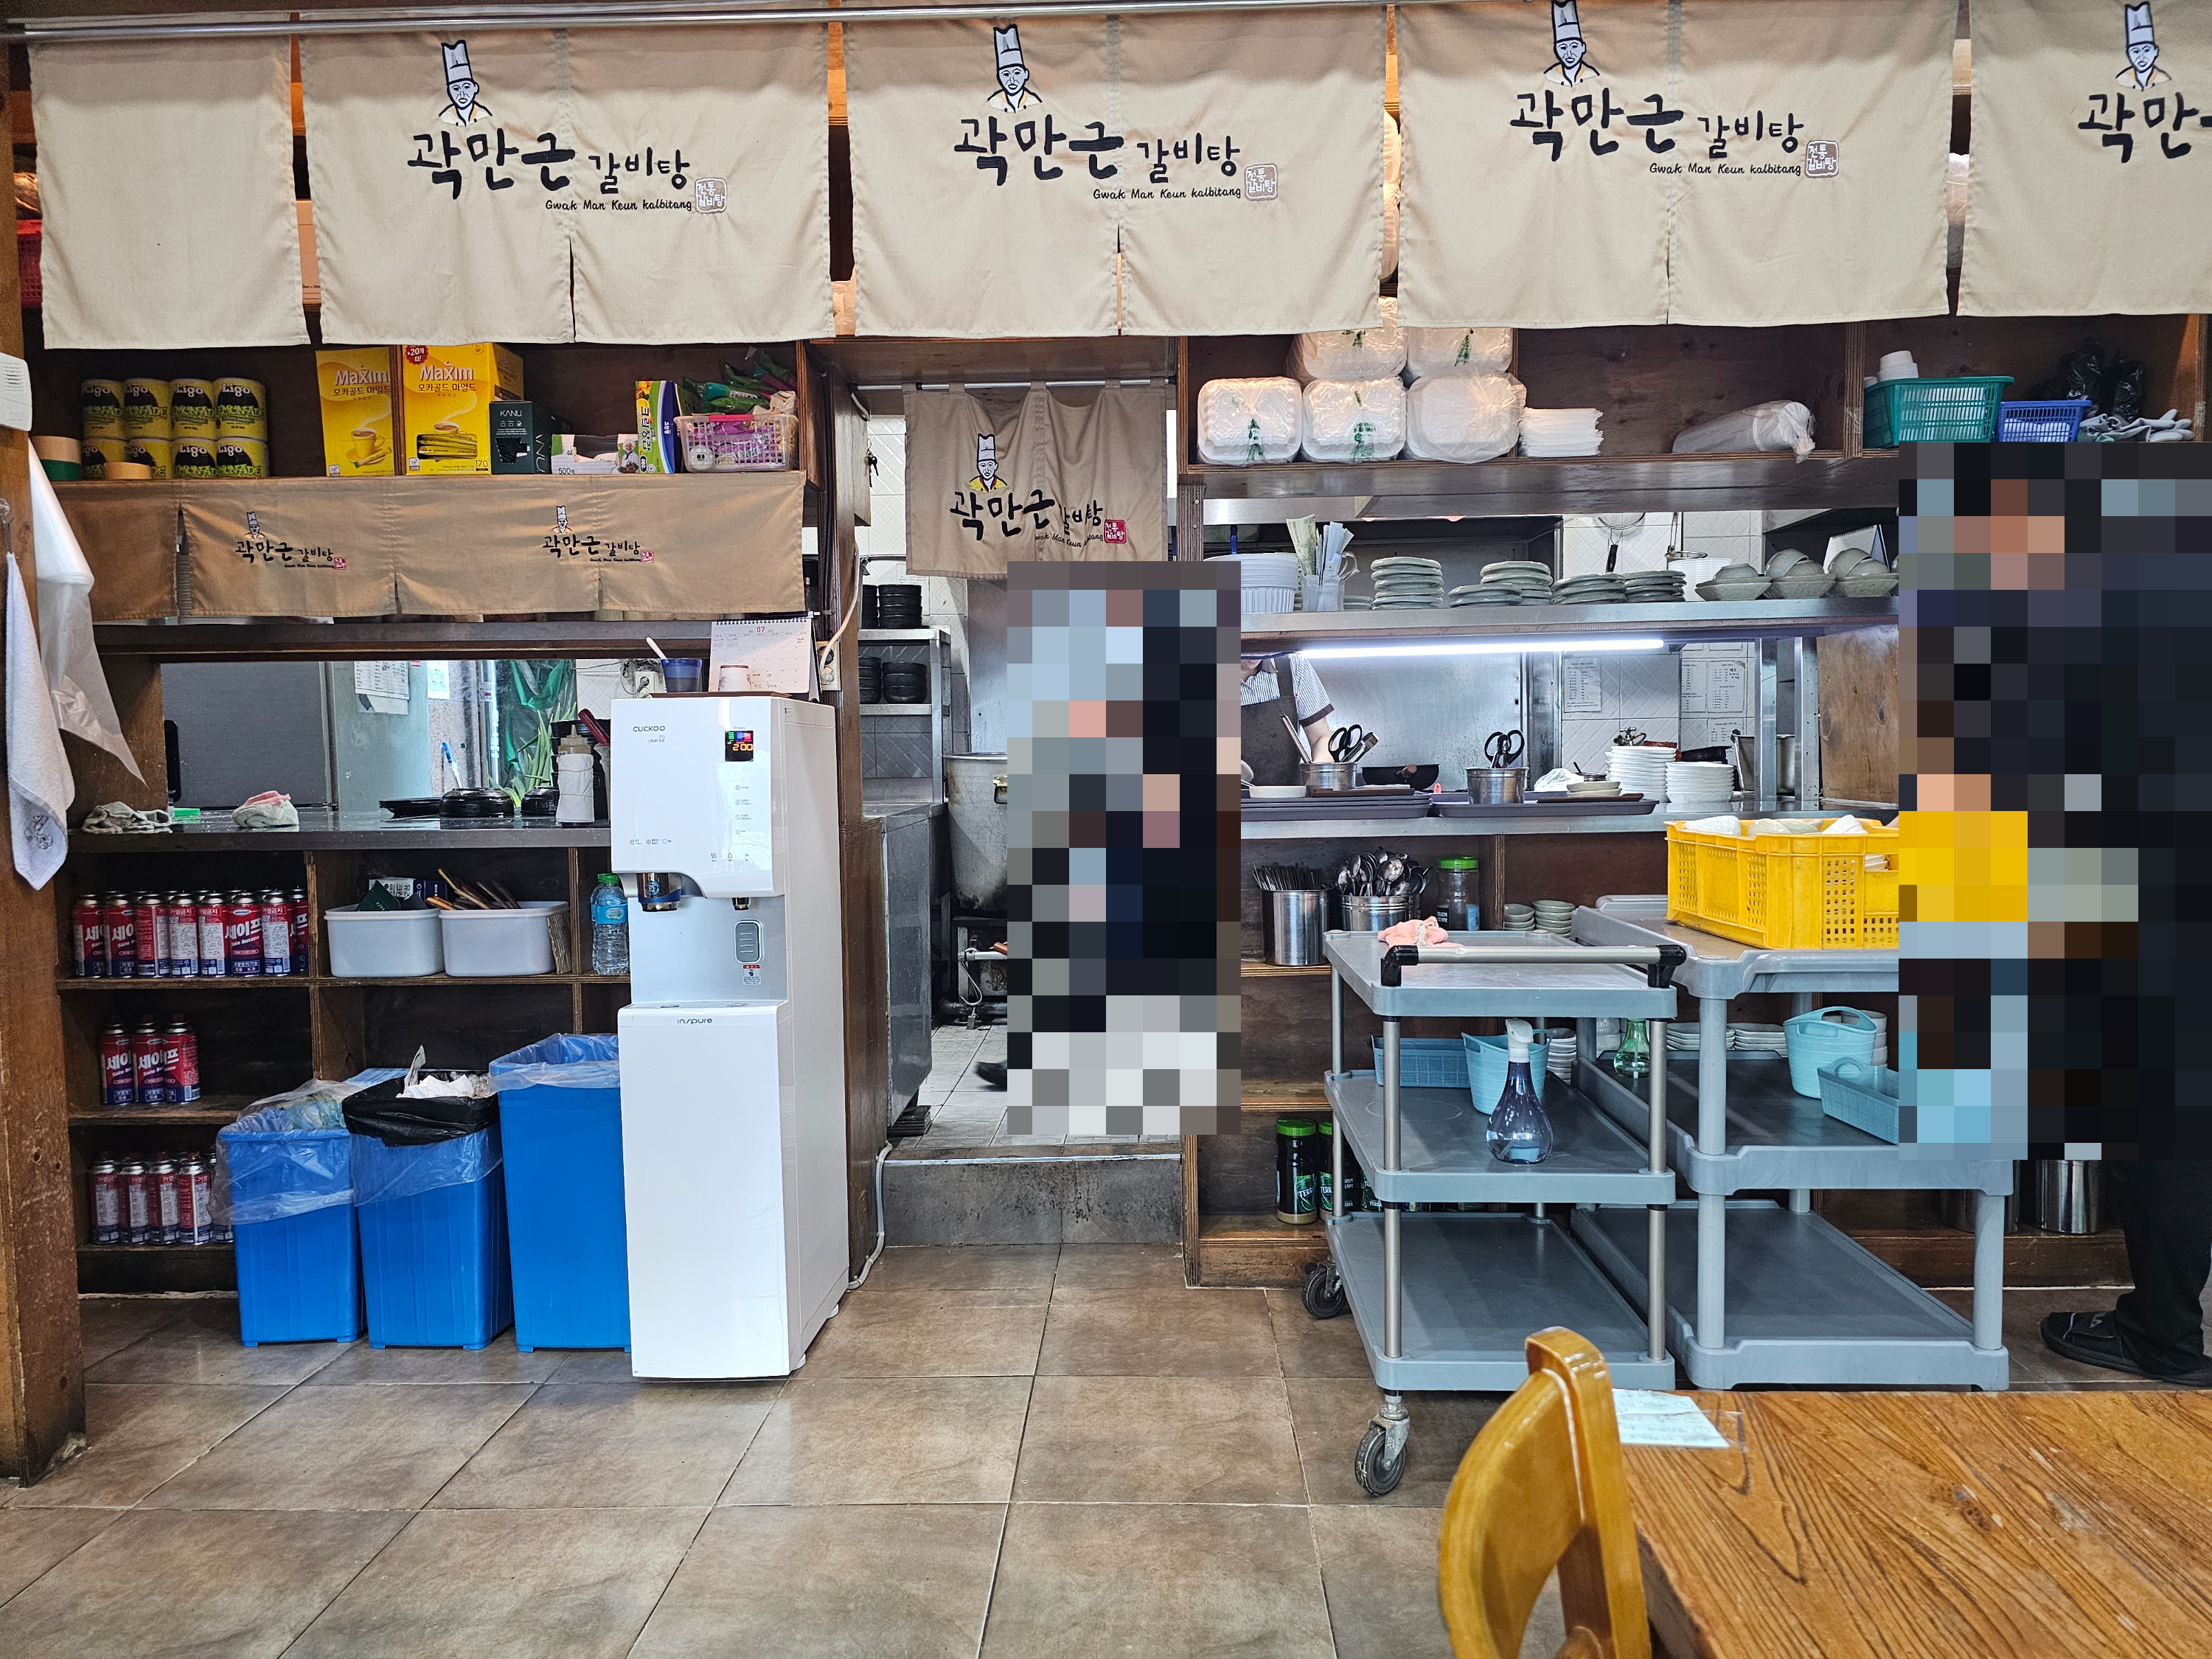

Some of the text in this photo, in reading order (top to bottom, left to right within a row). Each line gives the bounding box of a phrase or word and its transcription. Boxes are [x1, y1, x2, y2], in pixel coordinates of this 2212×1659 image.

[1510, 88, 1804, 162] 곽만근 갈비탕
[2077, 92, 2212, 163] 곽만
[954, 114, 1240, 187] 곽만근 갈비탕
[1808, 144, 1828, 159] 전통
[407, 128, 691, 200] 곽만근 갈비탕
[1649, 162, 1801, 176] Gwak Man Keun kalbitang
[1806, 156, 1837, 172] 갈비탕
[1247, 168, 1265, 183] 전통
[697, 181, 717, 196] 전통
[1093, 187, 1241, 200] Gwak Man Keun kalbitang
[1247, 179, 1276, 195] 갈비탕
[545, 198, 692, 212] Gwak Man Keun kalbitang
[697, 192, 726, 207] 갈비탕
[334, 366, 390, 386] Maxim
[419, 364, 475, 382] Maxim
[176, 384, 204, 398] Ligo
[222, 383, 251, 397] Ligo
[333, 384, 392, 397] 모카골드 마일드
[418, 383, 477, 392] 모카골드 마일드
[179, 444, 207, 458] Ligo
[218, 443, 243, 456] Ligo
[476, 459, 489, 467] 170
[950, 490, 1056, 541] 곽만근
[1034, 532, 1050, 542] wak
[234, 540, 334, 564] 곽만근 갈비탕
[543, 534, 641, 558] 곽만근 갈비탕
[225, 918, 262, 940] 세이프
[1320, 1186, 1332, 1194] TERR
